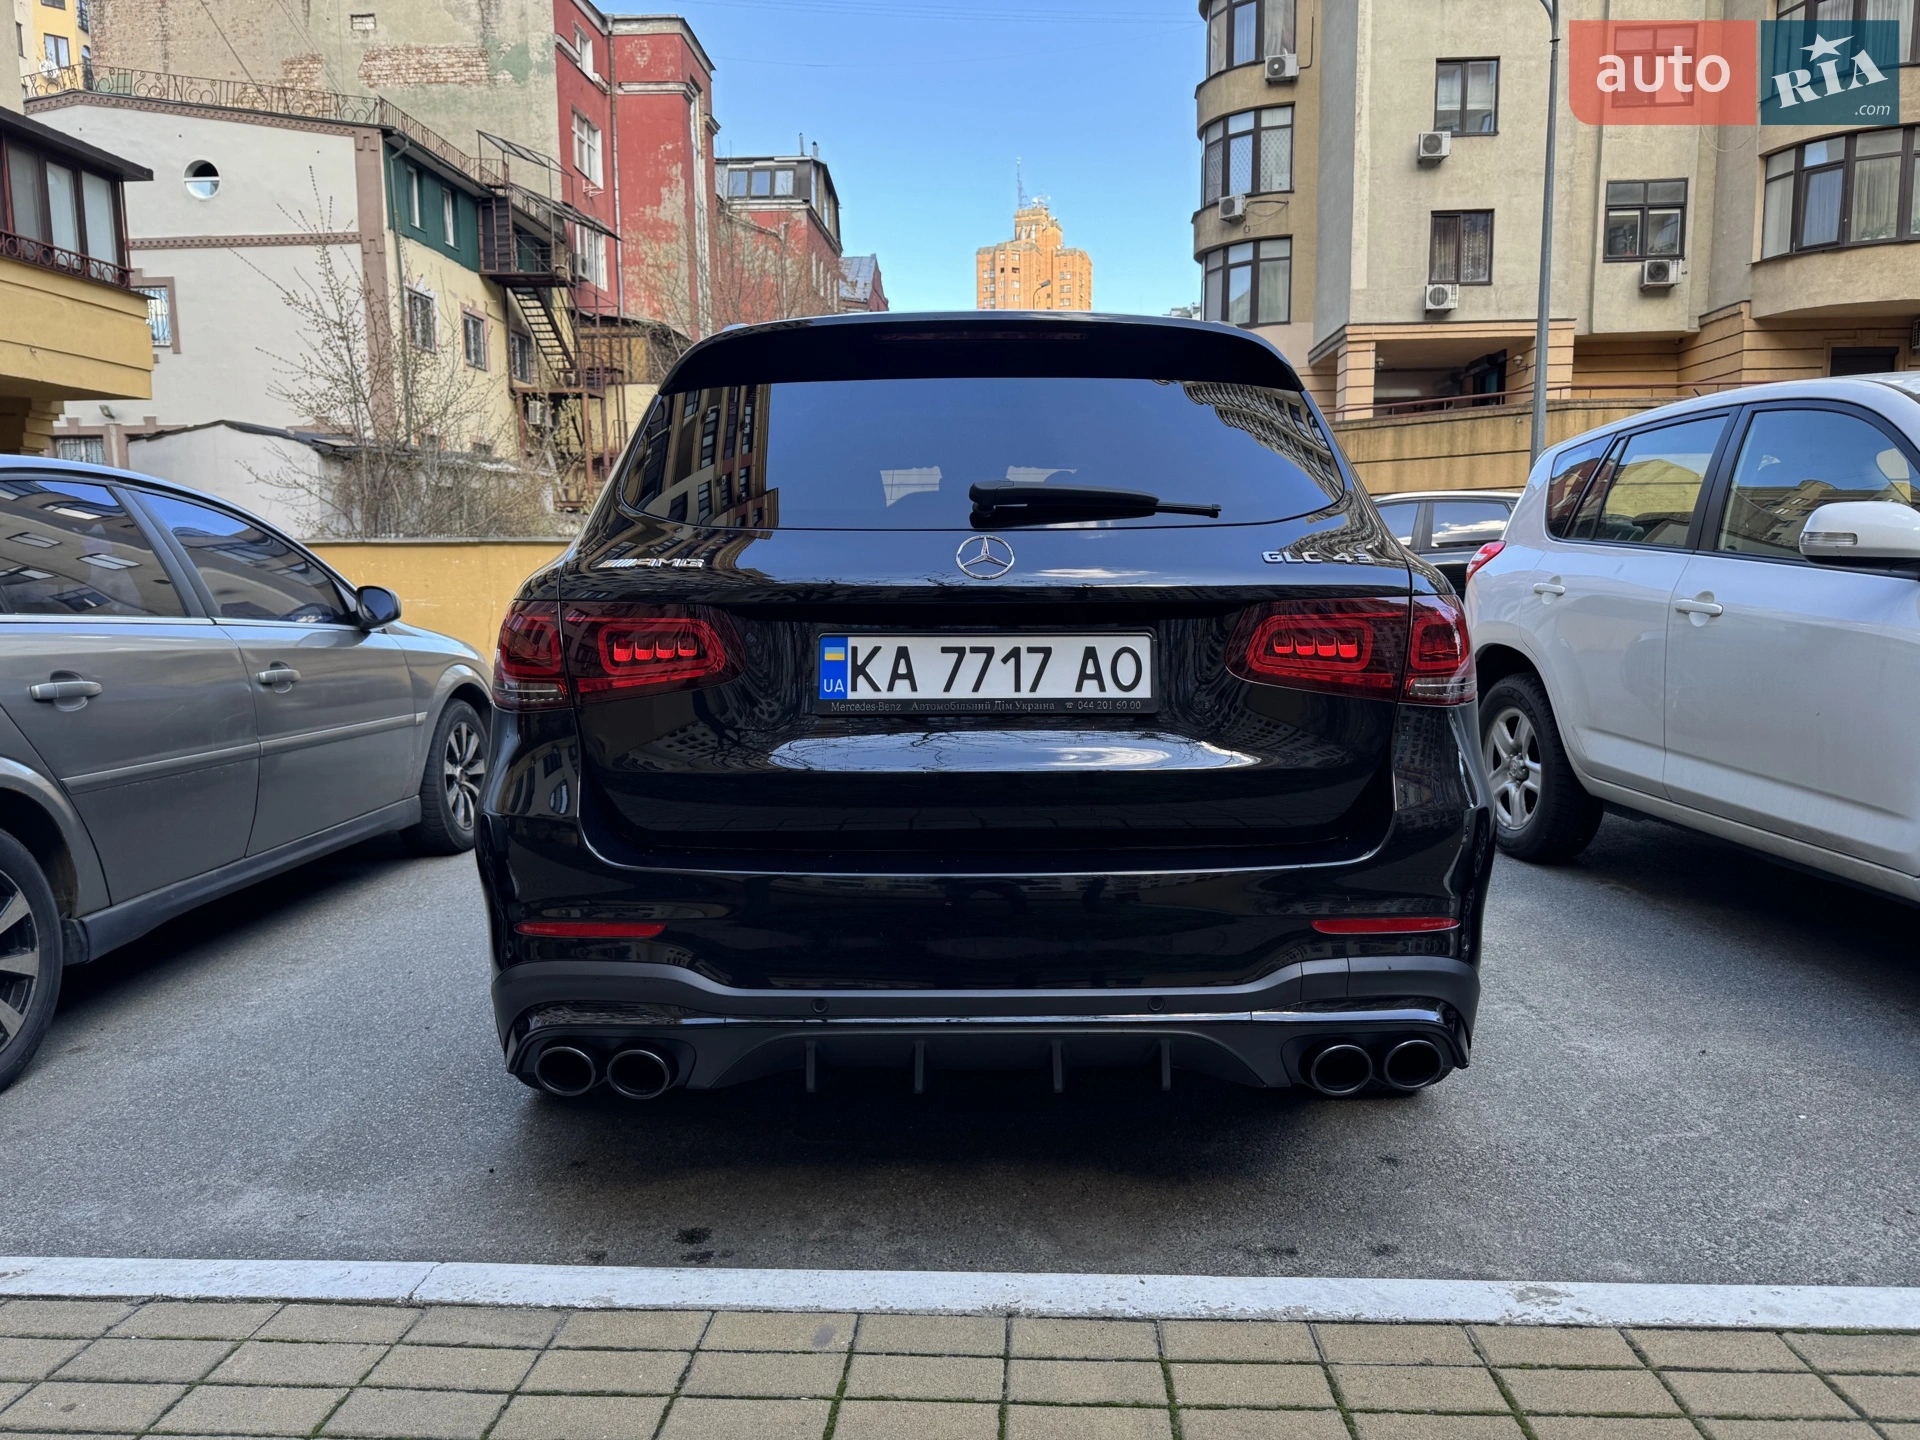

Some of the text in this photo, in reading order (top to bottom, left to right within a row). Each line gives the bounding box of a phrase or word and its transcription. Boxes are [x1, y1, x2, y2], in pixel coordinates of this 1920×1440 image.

[635, 558, 705, 568] AMG
[1262, 551, 1375, 564] GLC 43
[940, 645, 1053, 693] 7717
[823, 678, 845, 693] UA
[1077, 701, 1095, 710] 044
[1096, 701, 1113, 710] 201
[1116, 701, 1129, 710] 60
[1129, 701, 1142, 710] 00
